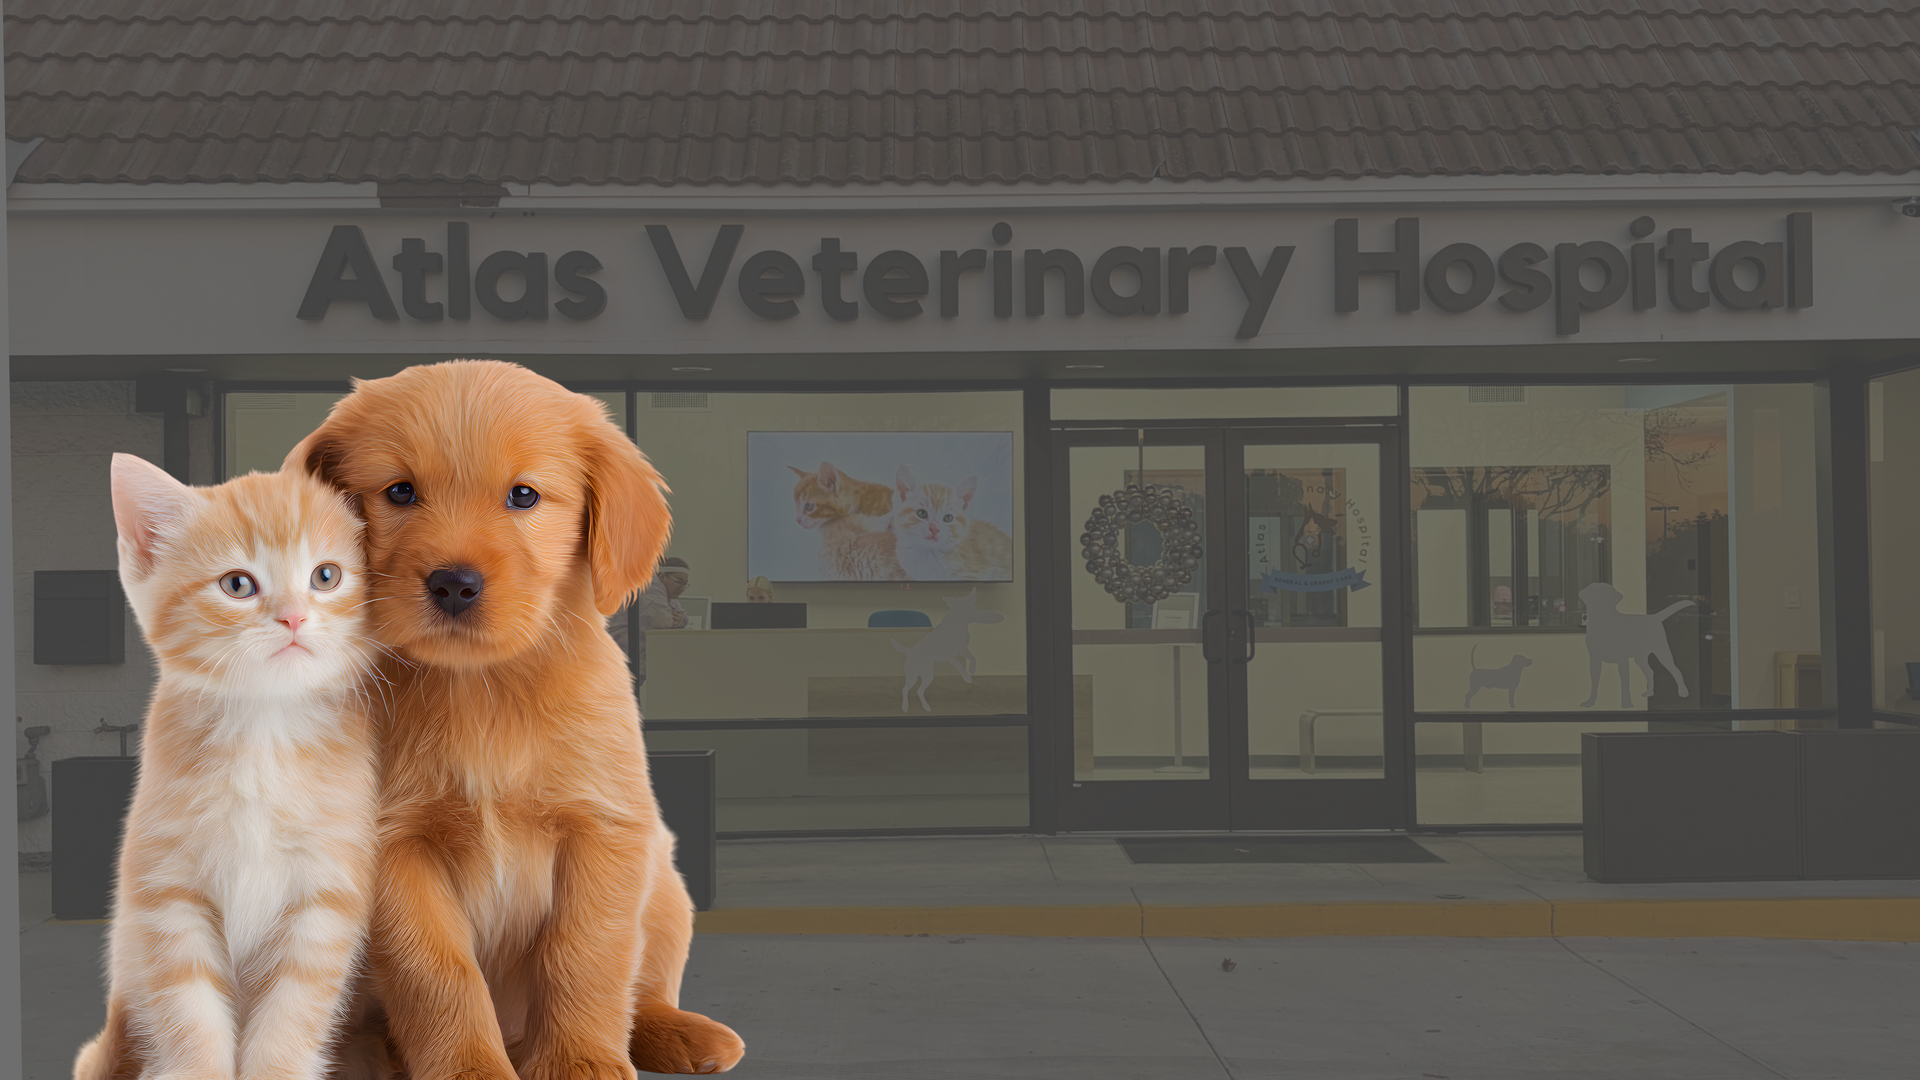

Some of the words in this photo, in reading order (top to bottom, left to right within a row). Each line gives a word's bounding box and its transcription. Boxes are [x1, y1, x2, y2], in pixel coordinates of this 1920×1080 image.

[296, 221, 607, 321] Atlas
[644, 221, 1296, 339] Veterinary
[1334, 212, 1813, 335] Hospital
[1255, 524, 1269, 563] Atlas
[1345, 498, 1371, 564] Hospital
[1274, 577, 1302, 586] GENERAL
[1310, 578, 1334, 587] URGENT
[1336, 574, 1352, 583] CARE
